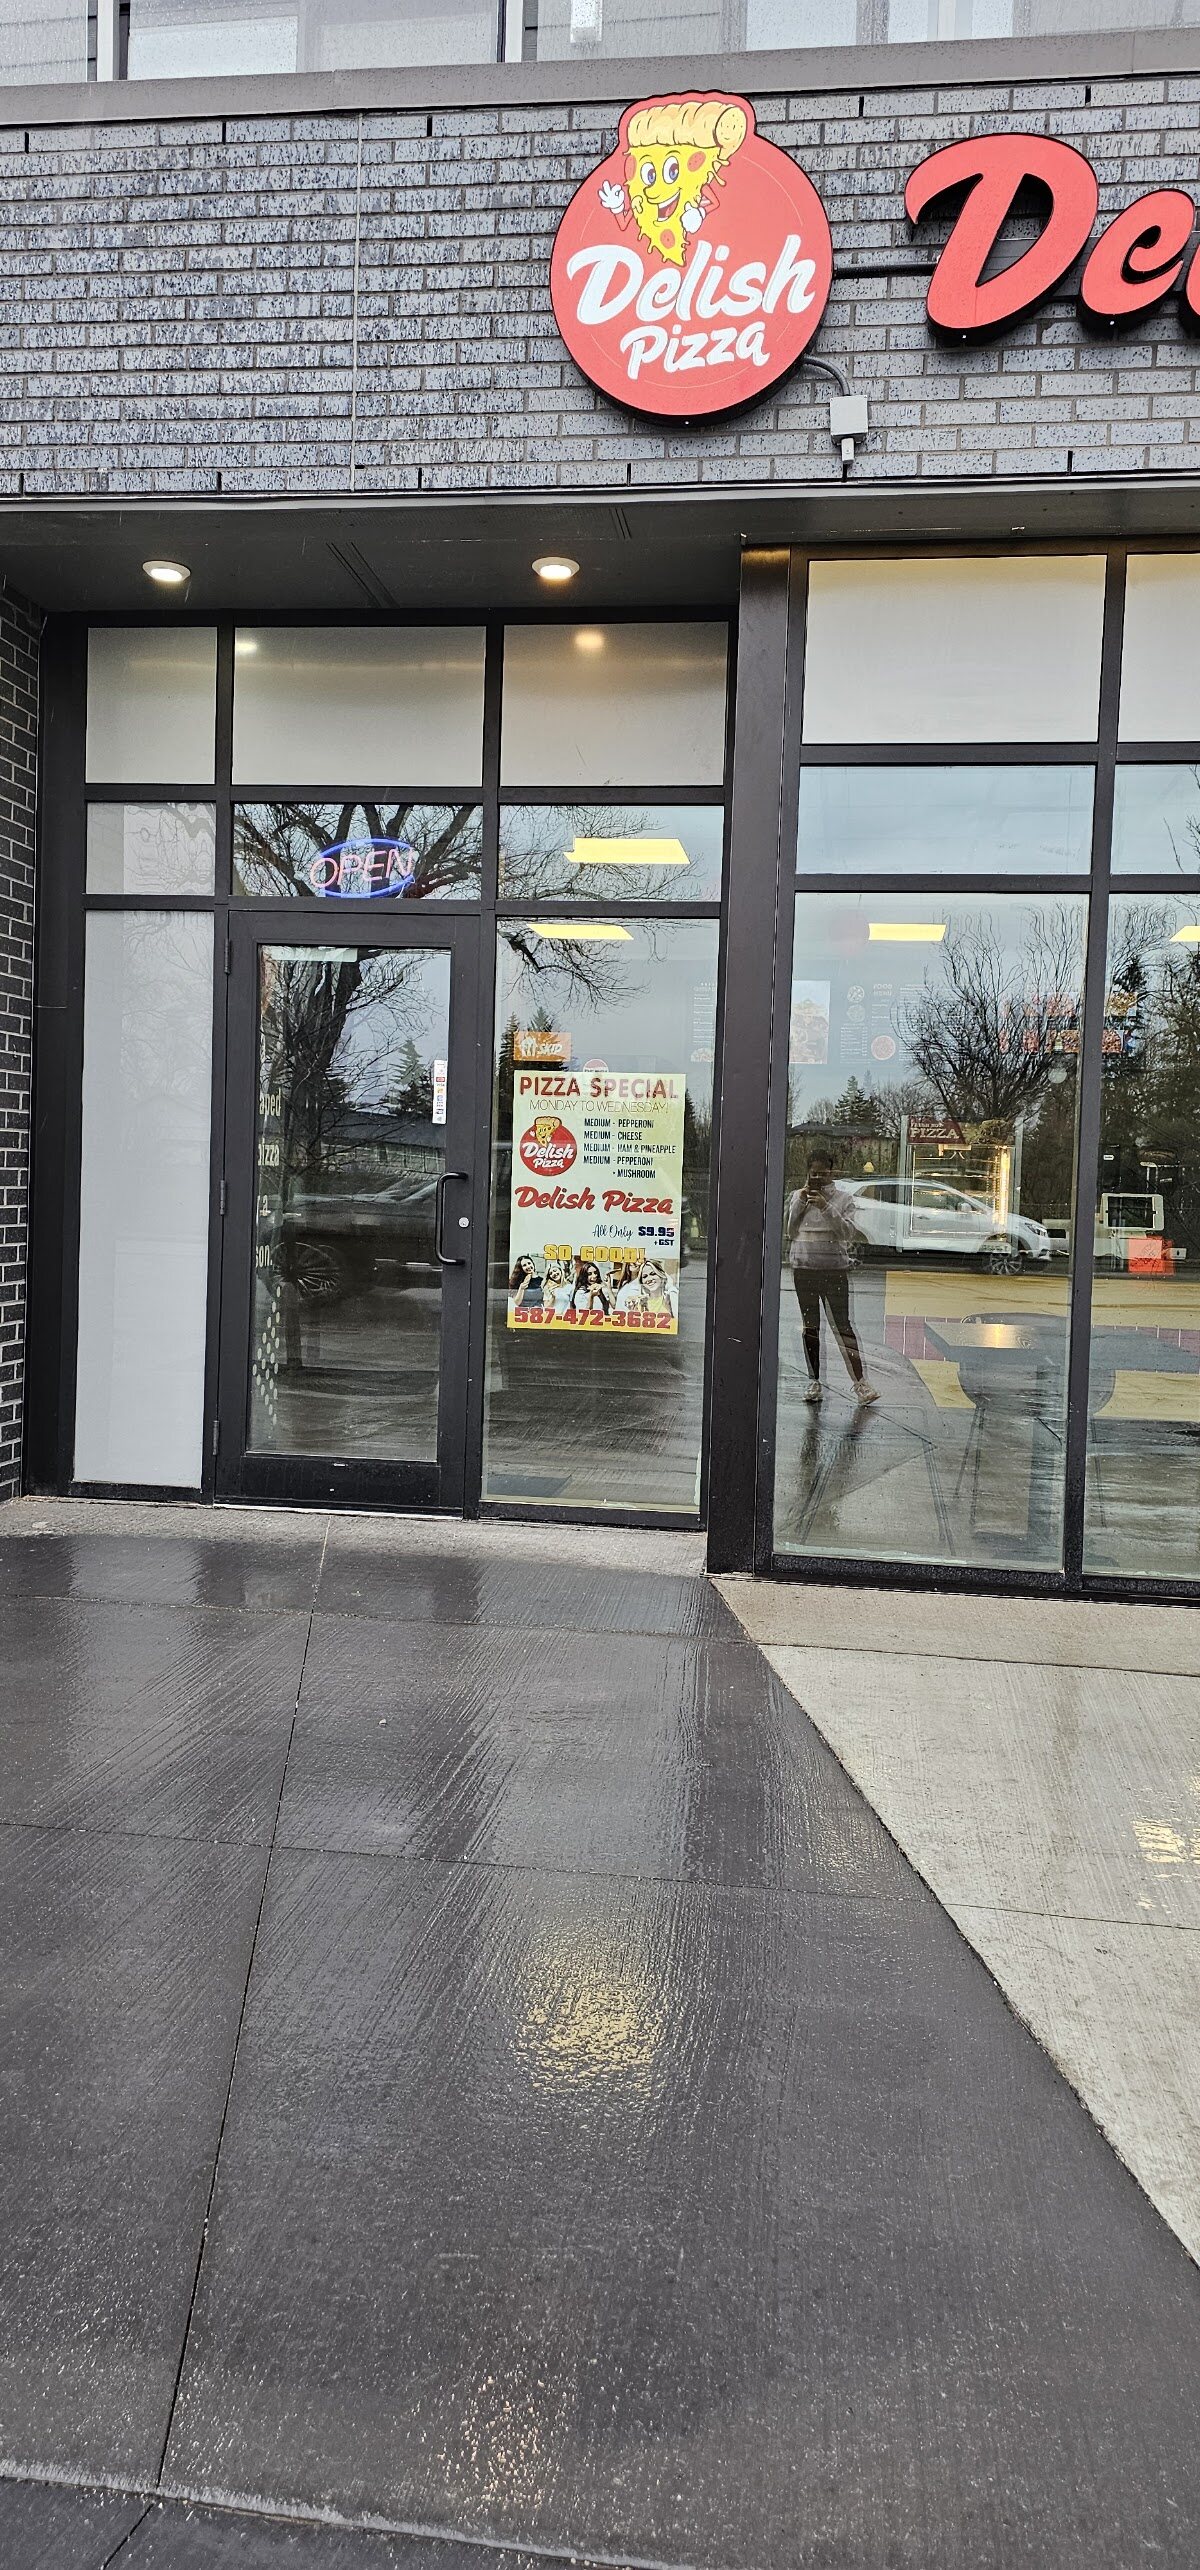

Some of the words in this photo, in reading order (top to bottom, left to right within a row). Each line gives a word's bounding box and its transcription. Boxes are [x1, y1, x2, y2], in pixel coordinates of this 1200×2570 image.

[905, 133, 1200, 332] De
[566, 234, 816, 325] Delish
[619, 321, 770, 380] Pizza
[310, 847, 413, 888] OPEN
[520, 1077, 580, 1096] PIZZA
[590, 1077, 678, 1099] SPECIAL
[529, 1099, 577, 1111] MONDAY
[580, 1101, 595, 1111] TO
[596, 1101, 669, 1114] WEDNESDAY!
[584, 1118, 611, 1127] MEDIUM
[618, 1119, 654, 1128] PEPPERONI
[584, 1131, 611, 1139] MEDIUM
[617, 1132, 643, 1140] CHEESE
[910, 1127, 960, 1139] PIZZA
[522, 1142, 574, 1158] Delish
[583, 1143, 611, 1152] MEDIUM
[640, 1145, 677, 1154] PINEAPPLE
[533, 1157, 564, 1169] Pizza
[583, 1156, 611, 1165] MEDIUM
[617, 1156, 654, 1165] PEPPERONI
[617, 1169, 656, 1179] MUSHROOM
[514, 1185, 596, 1210] Delish
[601, 1189, 674, 1215] Pizza
[592, 1224, 608, 1238] All
[609, 1224, 634, 1241] Only
[638, 1226, 675, 1237] $9.95
[543, 1244, 573, 1262] SO
[580, 1245, 647, 1264] GOOD!
[514, 1307, 672, 1329] 587-472-3682
